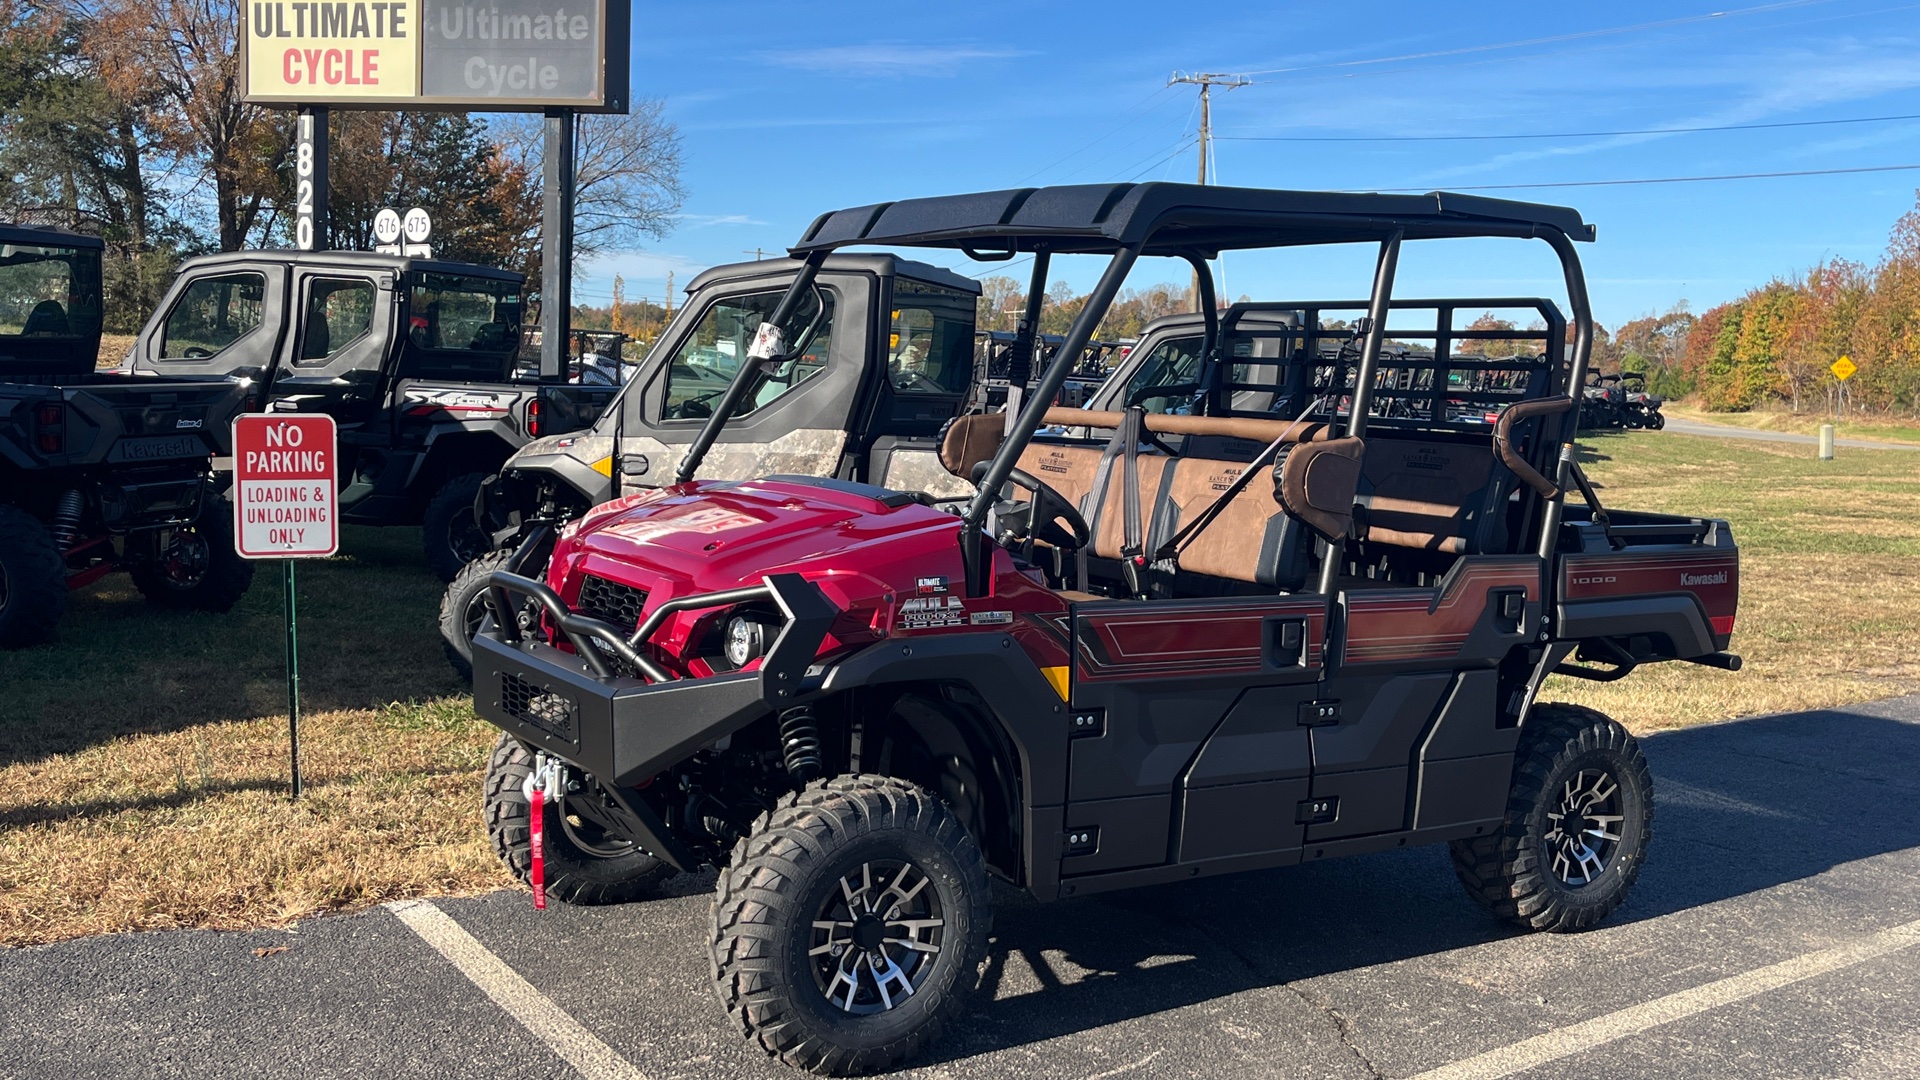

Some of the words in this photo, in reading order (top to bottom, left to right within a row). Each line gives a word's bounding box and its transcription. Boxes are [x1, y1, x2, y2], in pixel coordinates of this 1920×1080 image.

[254, 2, 407, 38] ULTIMATE
[440, 6, 589, 40] Ultimate
[283, 48, 380, 85] CYCLE
[464, 56, 560, 96] Cycle
[297, 107, 313, 250] 1820
[378, 218, 397, 233] 676
[407, 217, 427, 233] 675
[266, 425, 303, 447] NO
[122, 439, 195, 458] Kawasaki
[246, 451, 325, 473] PARKING
[248, 487, 307, 503] LOADING
[313, 486, 324, 501] &
[247, 507, 326, 523] UNLOADING
[269, 528, 305, 544] ONLY
[1572, 576, 1617, 584] 1000
[1680, 571, 1728, 586] Kawasaki
[898, 596, 966, 615] MULE
[532, 832, 543, 858] WARN
[534, 884, 545, 906] WARN
